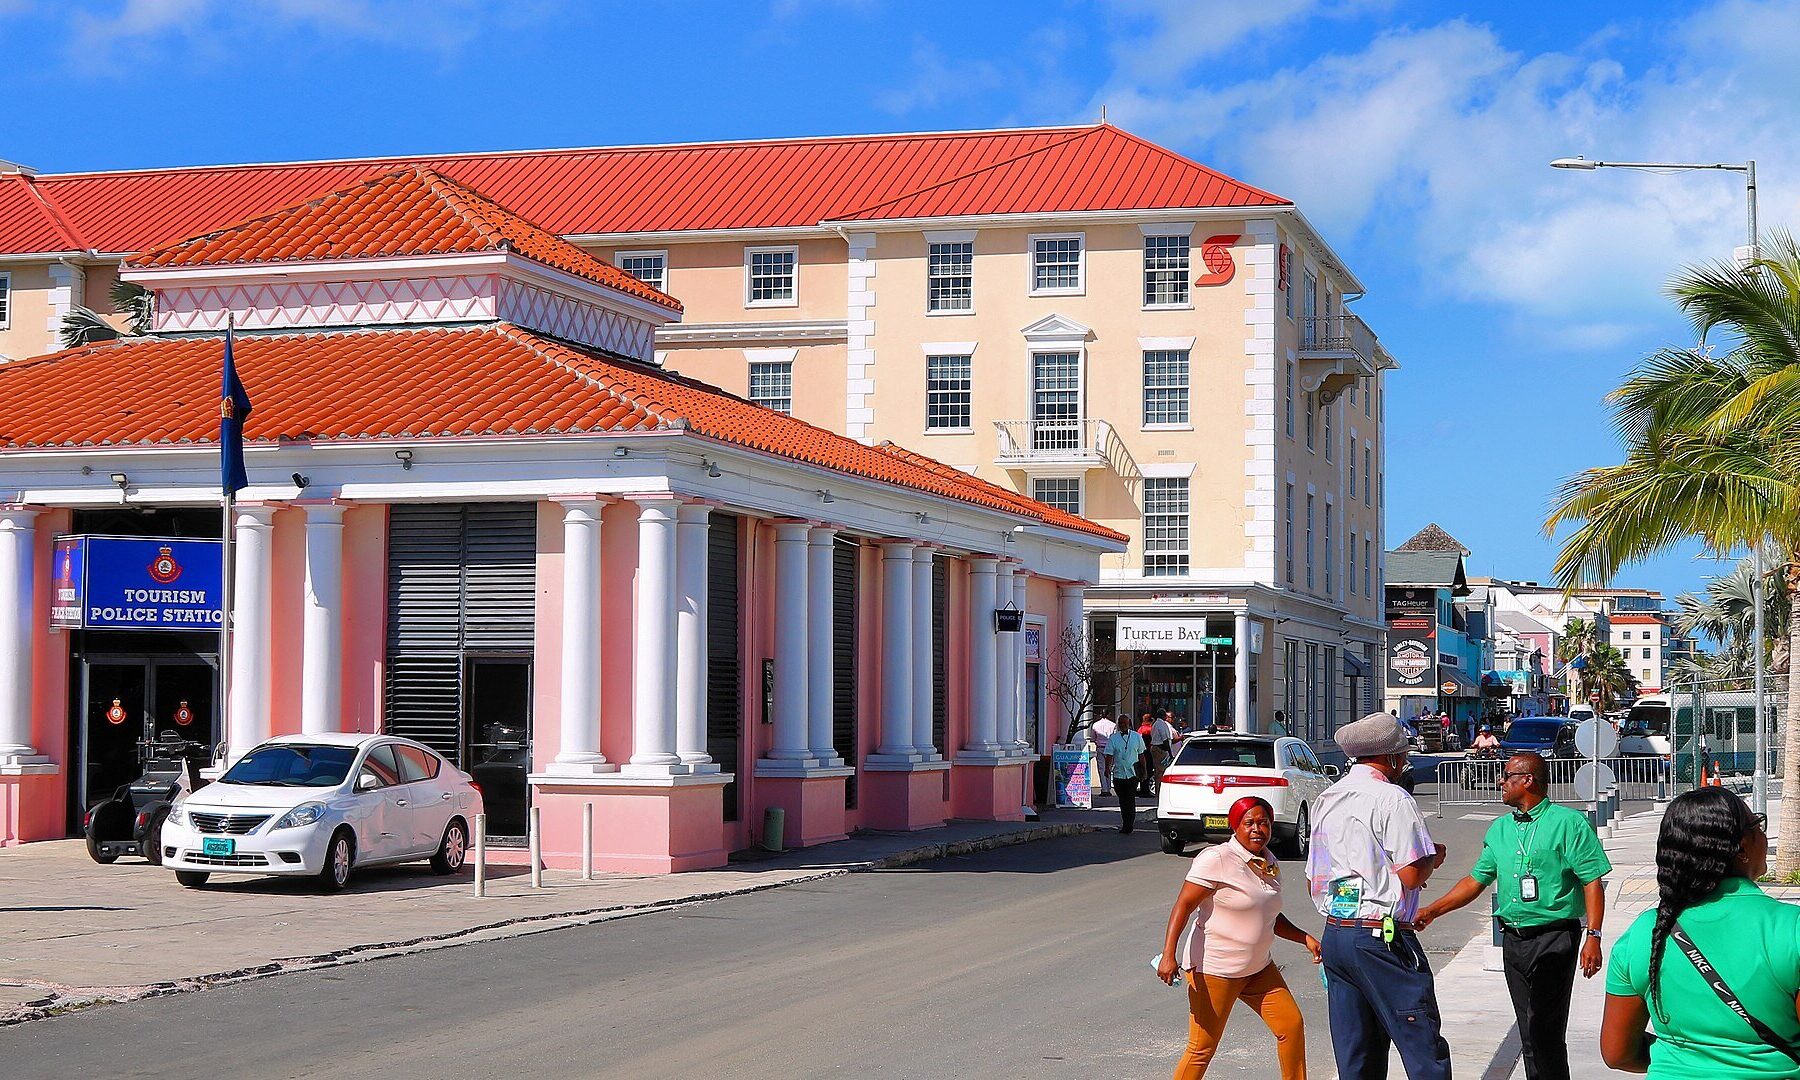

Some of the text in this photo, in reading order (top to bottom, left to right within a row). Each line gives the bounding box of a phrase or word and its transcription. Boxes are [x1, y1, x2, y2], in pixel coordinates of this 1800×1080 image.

[124, 589, 205, 603] TOURISM
[91, 607, 158, 622] POLICE
[1687, 949, 1712, 974] NIKE
